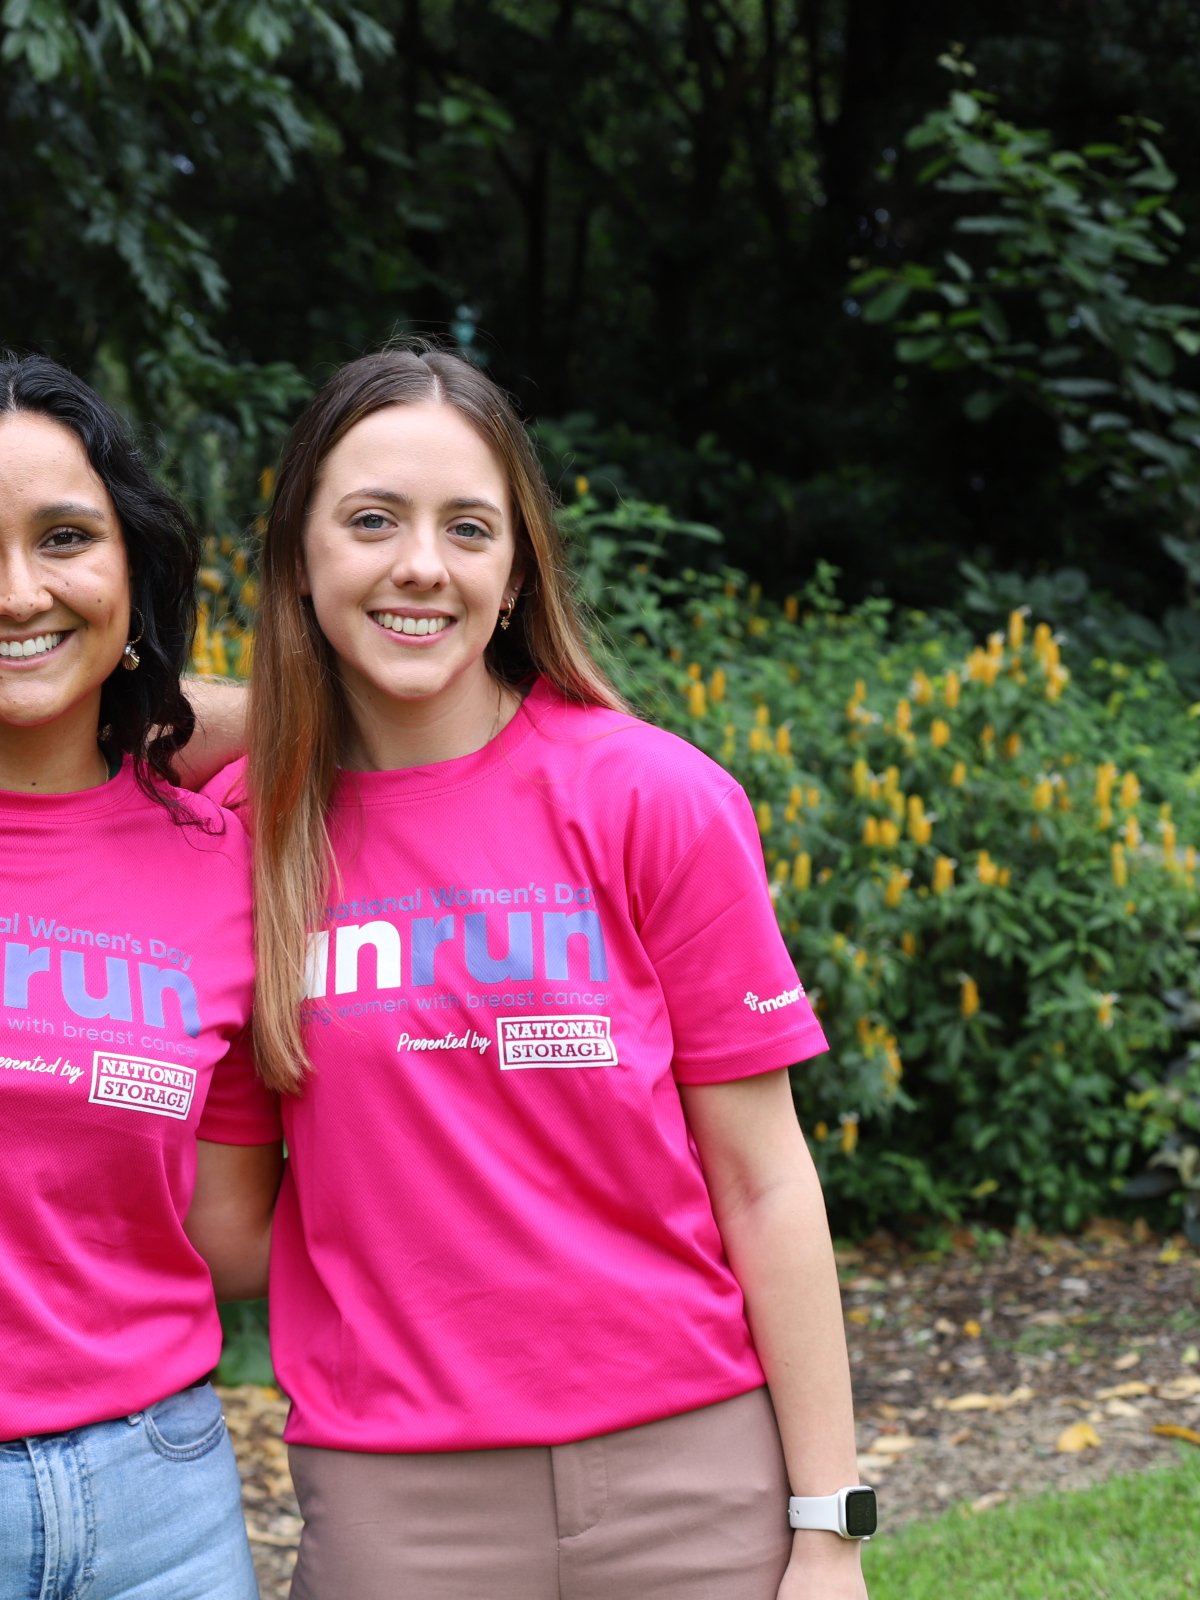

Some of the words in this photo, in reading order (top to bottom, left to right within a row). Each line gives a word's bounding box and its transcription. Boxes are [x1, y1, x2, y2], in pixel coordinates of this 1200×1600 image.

[430, 882, 547, 909] Women's
[28, 915, 142, 955] Women's
[149, 938, 193, 971] Day
[338, 997, 409, 1019] women
[416, 991, 460, 1010] with
[467, 989, 535, 1008] breast
[8, 1015, 55, 1036] with
[63, 1021, 134, 1046] breast
[397, 1029, 471, 1053] Presented
[470, 1031, 491, 1055] by
[504, 1021, 605, 1040] NATIONAL
[512, 1042, 606, 1060] STORAGE
[60, 1059, 85, 1085] by
[101, 1058, 192, 1090] NATIONAL
[104, 1080, 186, 1109] STORAGE
